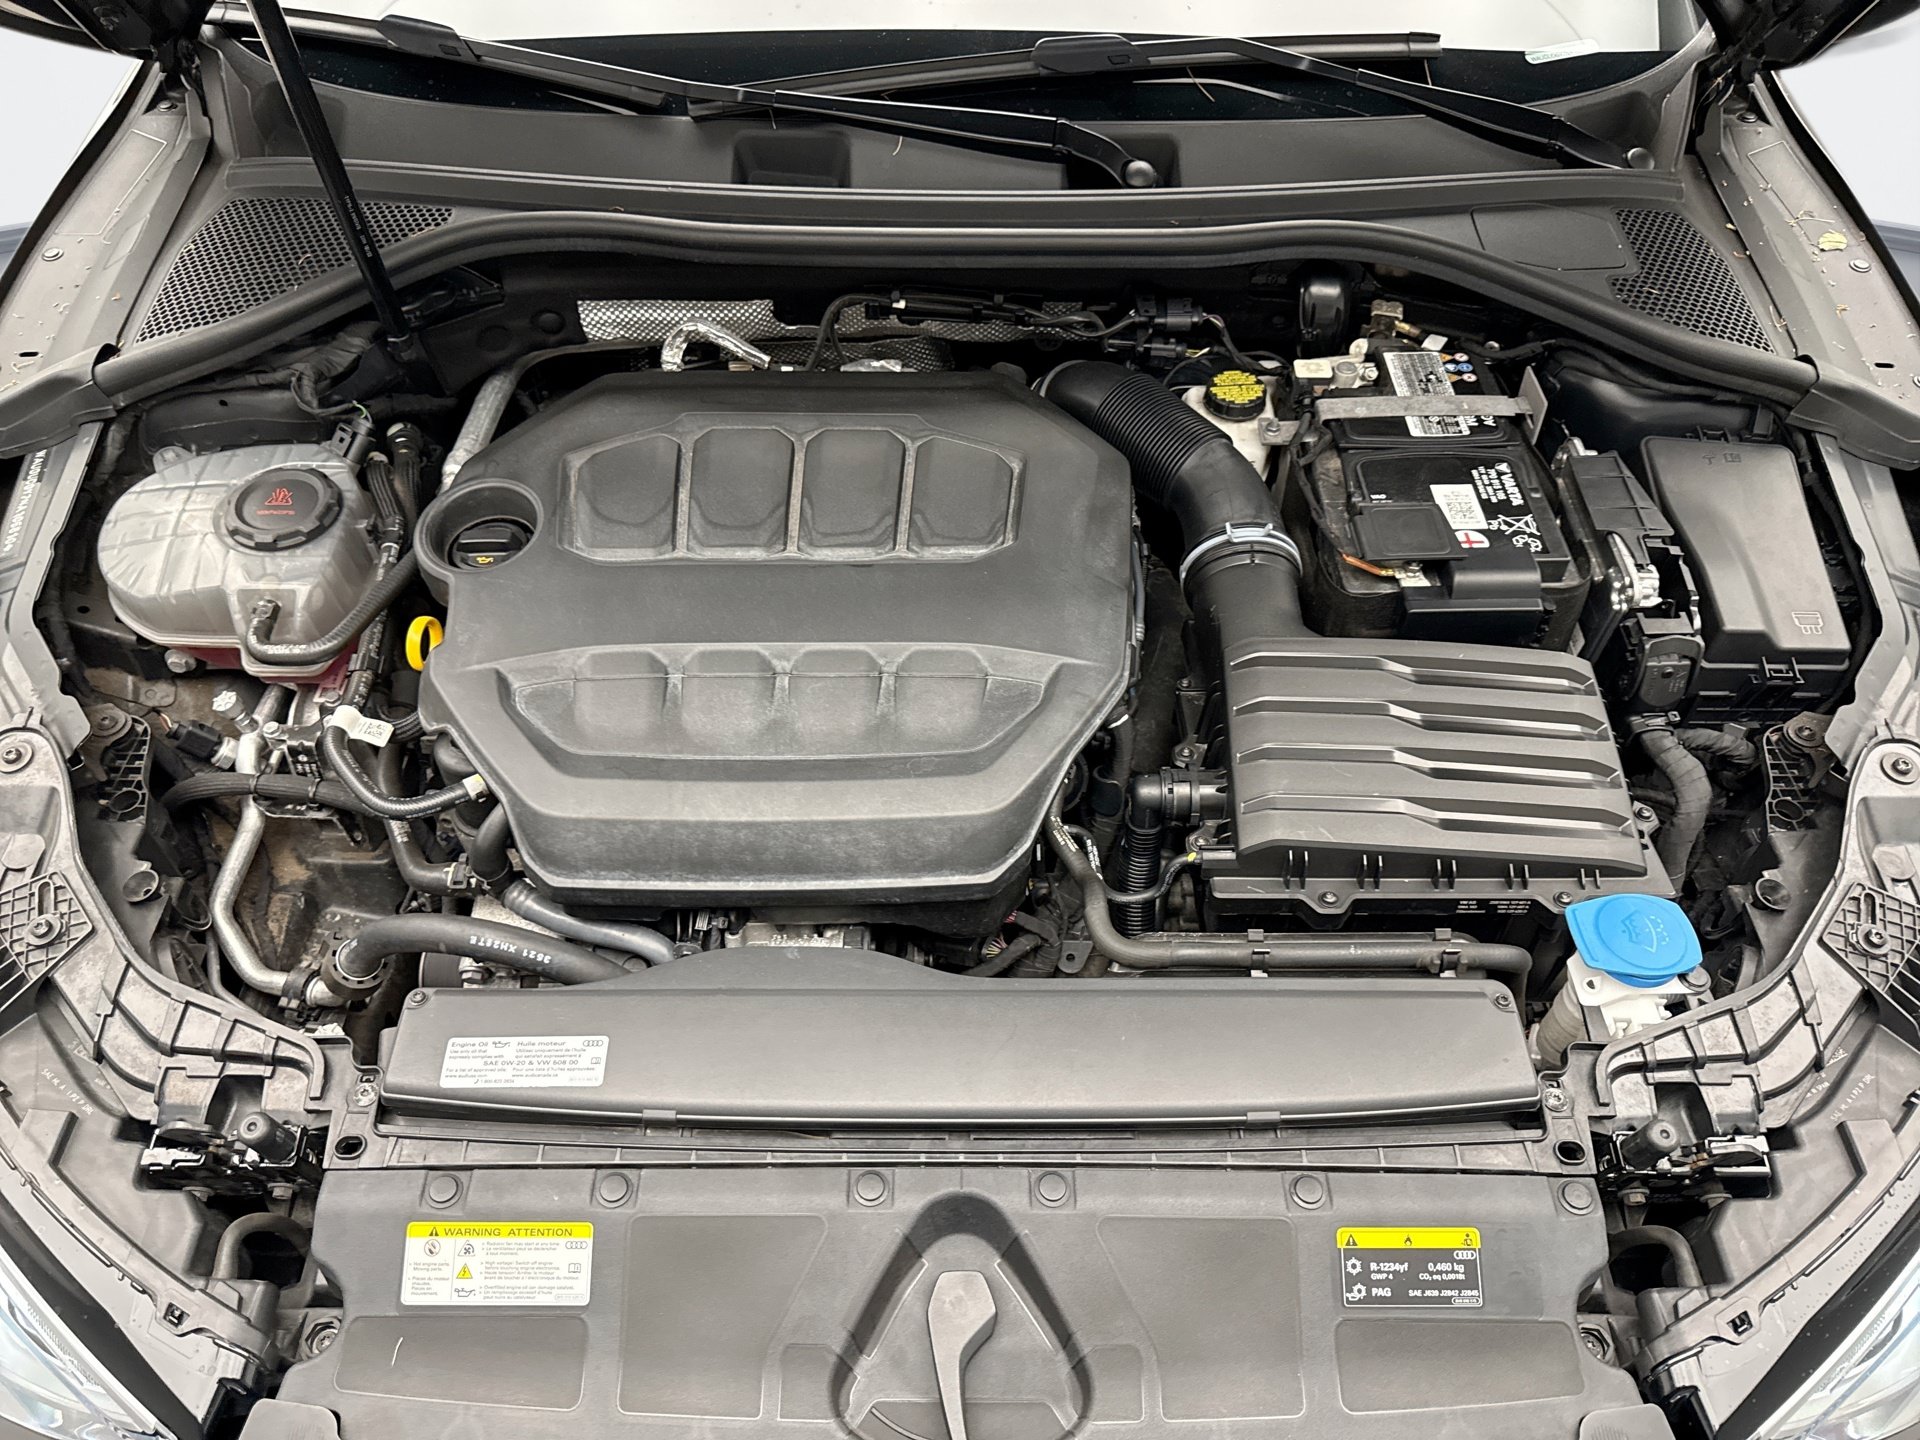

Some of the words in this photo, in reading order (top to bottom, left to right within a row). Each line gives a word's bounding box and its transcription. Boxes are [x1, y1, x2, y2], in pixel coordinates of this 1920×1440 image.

[1501, 474, 1524, 506] VARTA
[444, 1228, 500, 1236] WARNING
[508, 1228, 572, 1236] ATTENTION
[1370, 1262, 1408, 1273] R-1234yf
[1428, 1262, 1452, 1272] 0,460
[1454, 1262, 1464, 1273] kg
[1372, 1288, 1392, 1297] PAG
